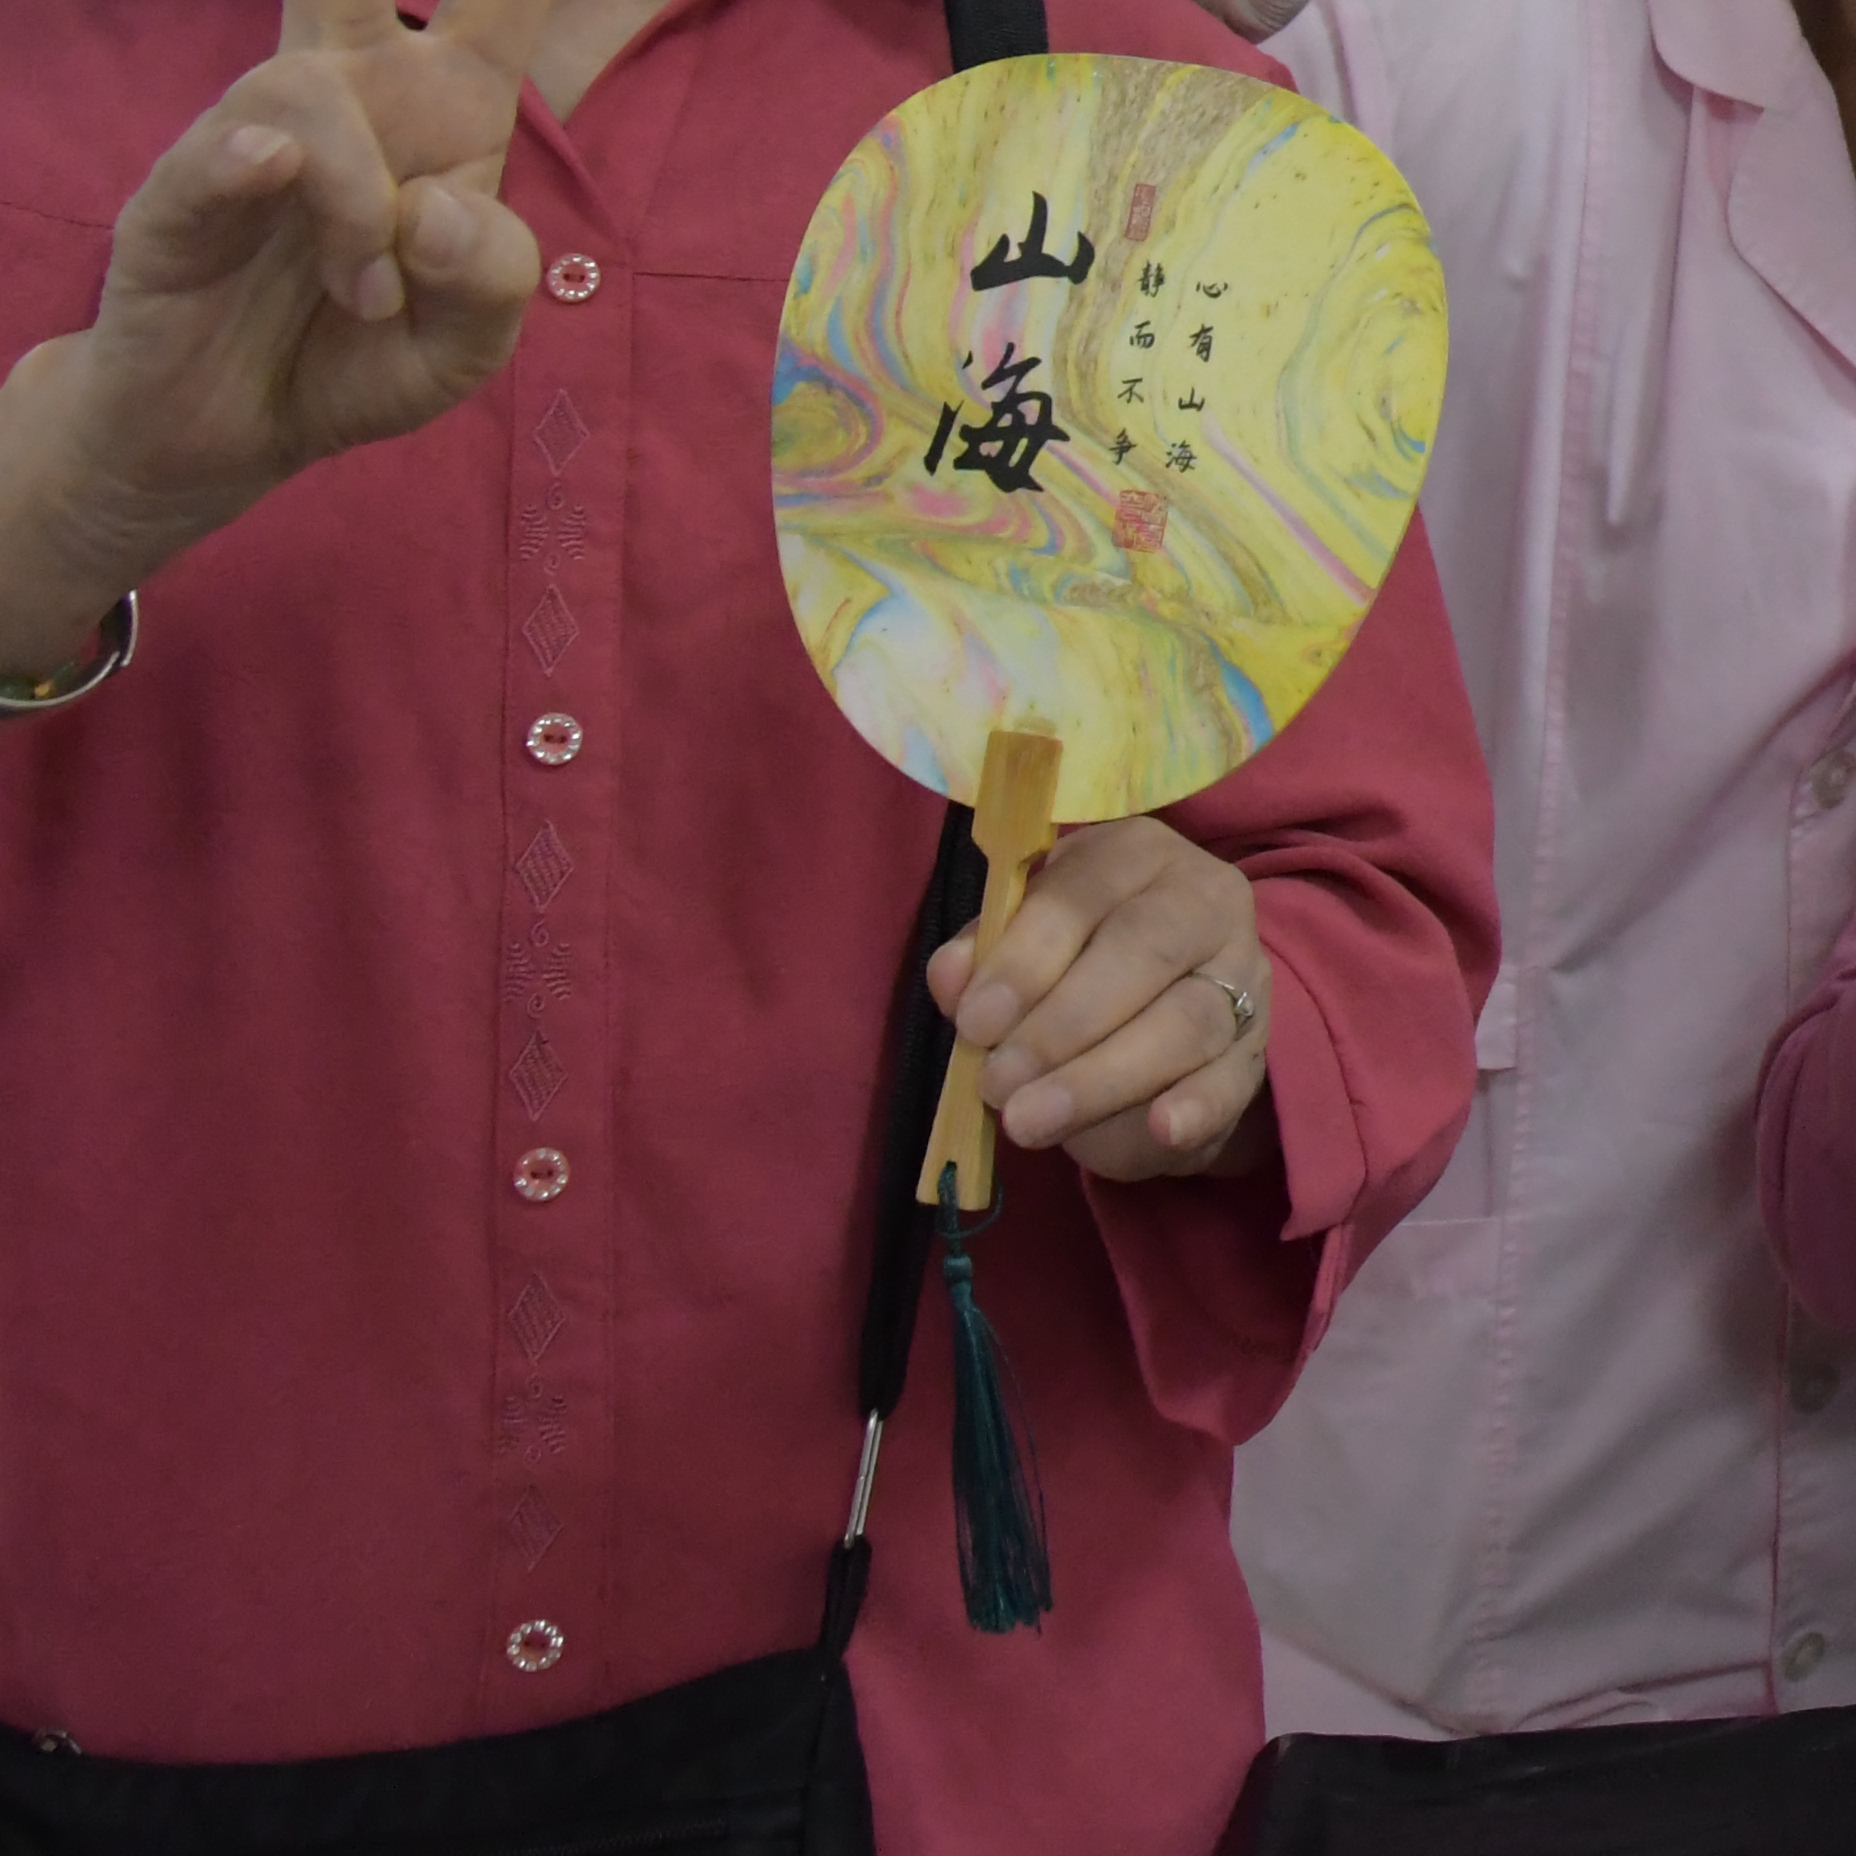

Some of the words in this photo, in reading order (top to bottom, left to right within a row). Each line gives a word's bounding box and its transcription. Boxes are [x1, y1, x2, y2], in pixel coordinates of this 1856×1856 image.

[923, 190, 1096, 494] 山海
[1109, 259, 1166, 466] 静而不争
[1165, 280, 1229, 474] 心有山海
